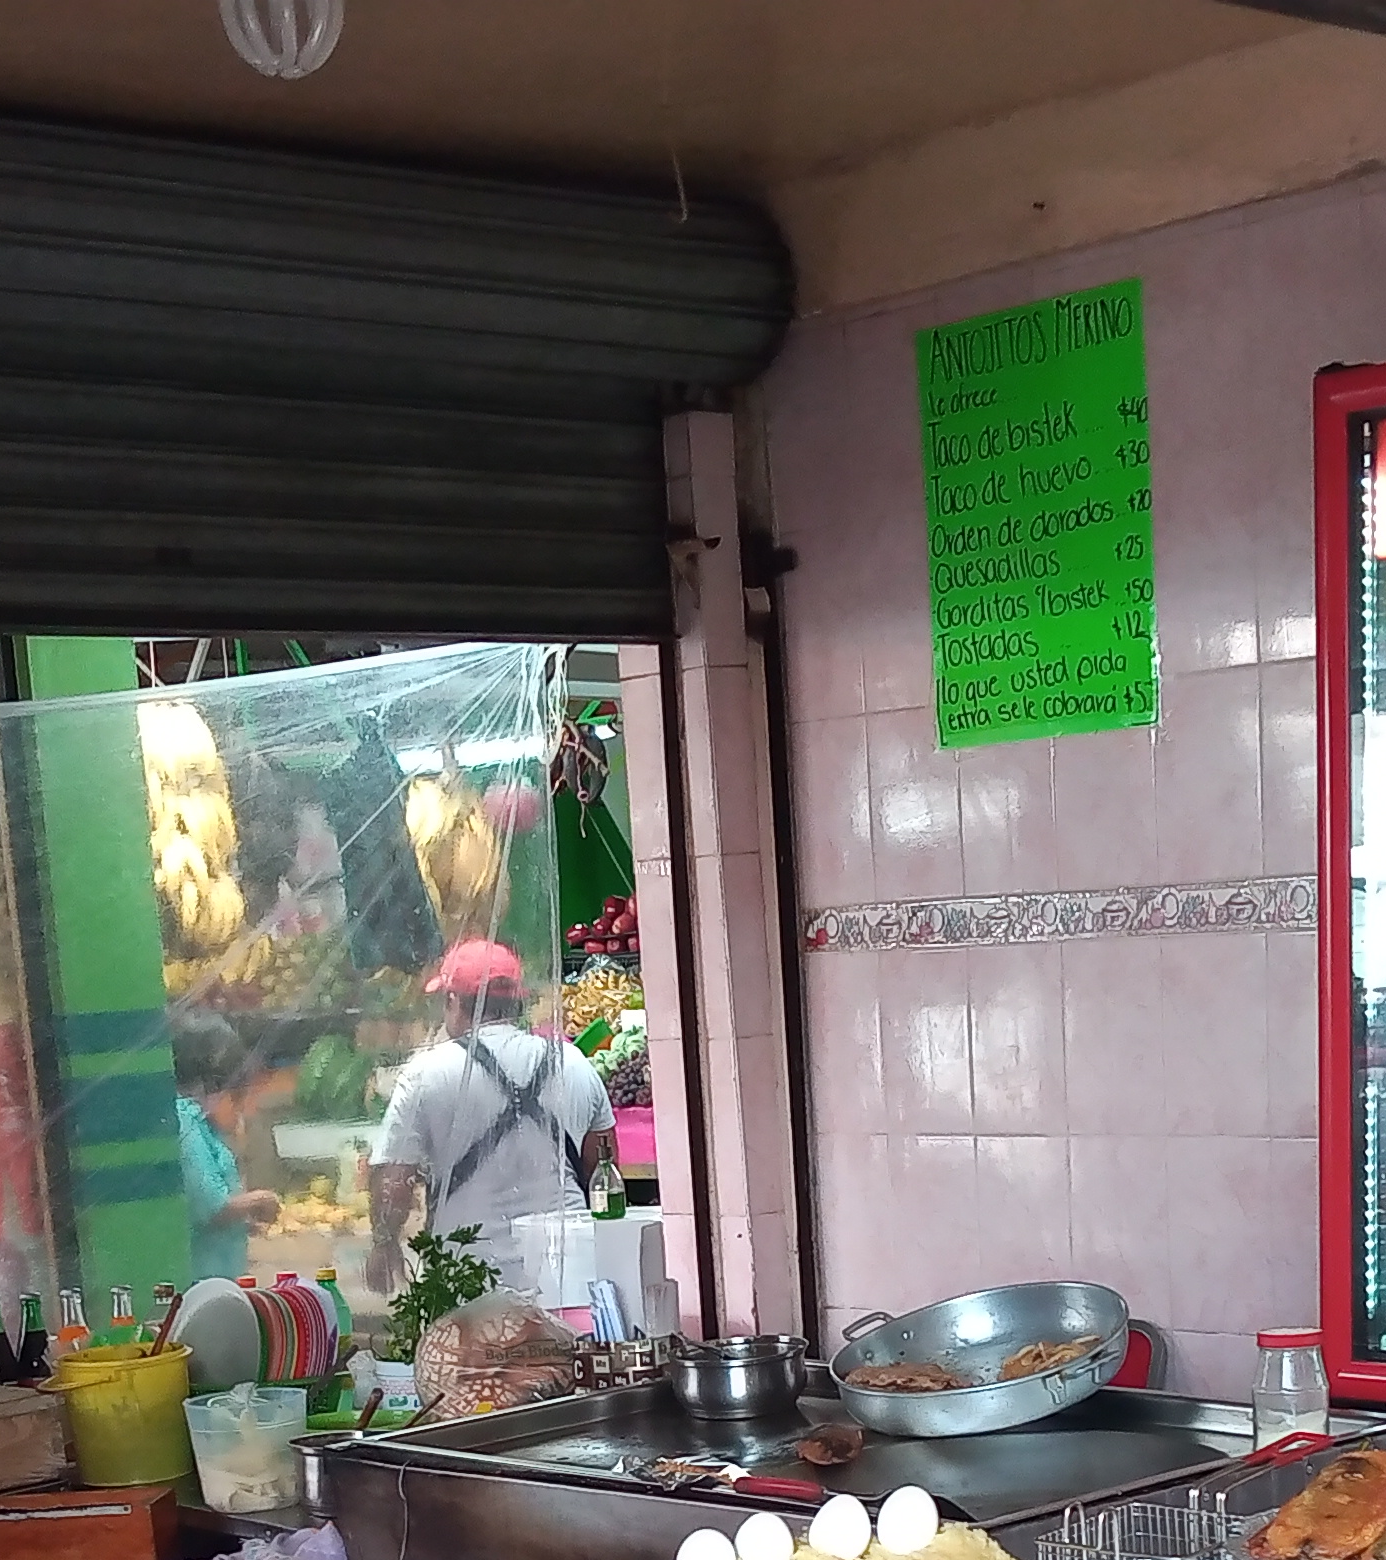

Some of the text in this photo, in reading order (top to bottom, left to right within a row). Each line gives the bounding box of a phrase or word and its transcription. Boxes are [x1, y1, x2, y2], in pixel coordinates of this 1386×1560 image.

[929, 297, 1134, 385] ANTOJITOS MERINO
[928, 420, 972, 470] Taco
[977, 425, 1005, 460] de
[1007, 400, 1078, 453] bistek
[931, 473, 977, 516] Taco
[981, 468, 1011, 504] de
[1019, 456, 1092, 499] huevo
[931, 522, 991, 559] Orden
[997, 515, 1024, 548] de
[1029, 498, 1114, 543] dorados
[934, 547, 1061, 595] Quesadillas
[936, 591, 1030, 630] Gorditas
[937, 629, 1040, 670] Tostadas
[965, 675, 1003, 706] que
[1011, 656, 1070, 692] usted
[1077, 648, 1127, 685] pida
[948, 704, 992, 731] extra
